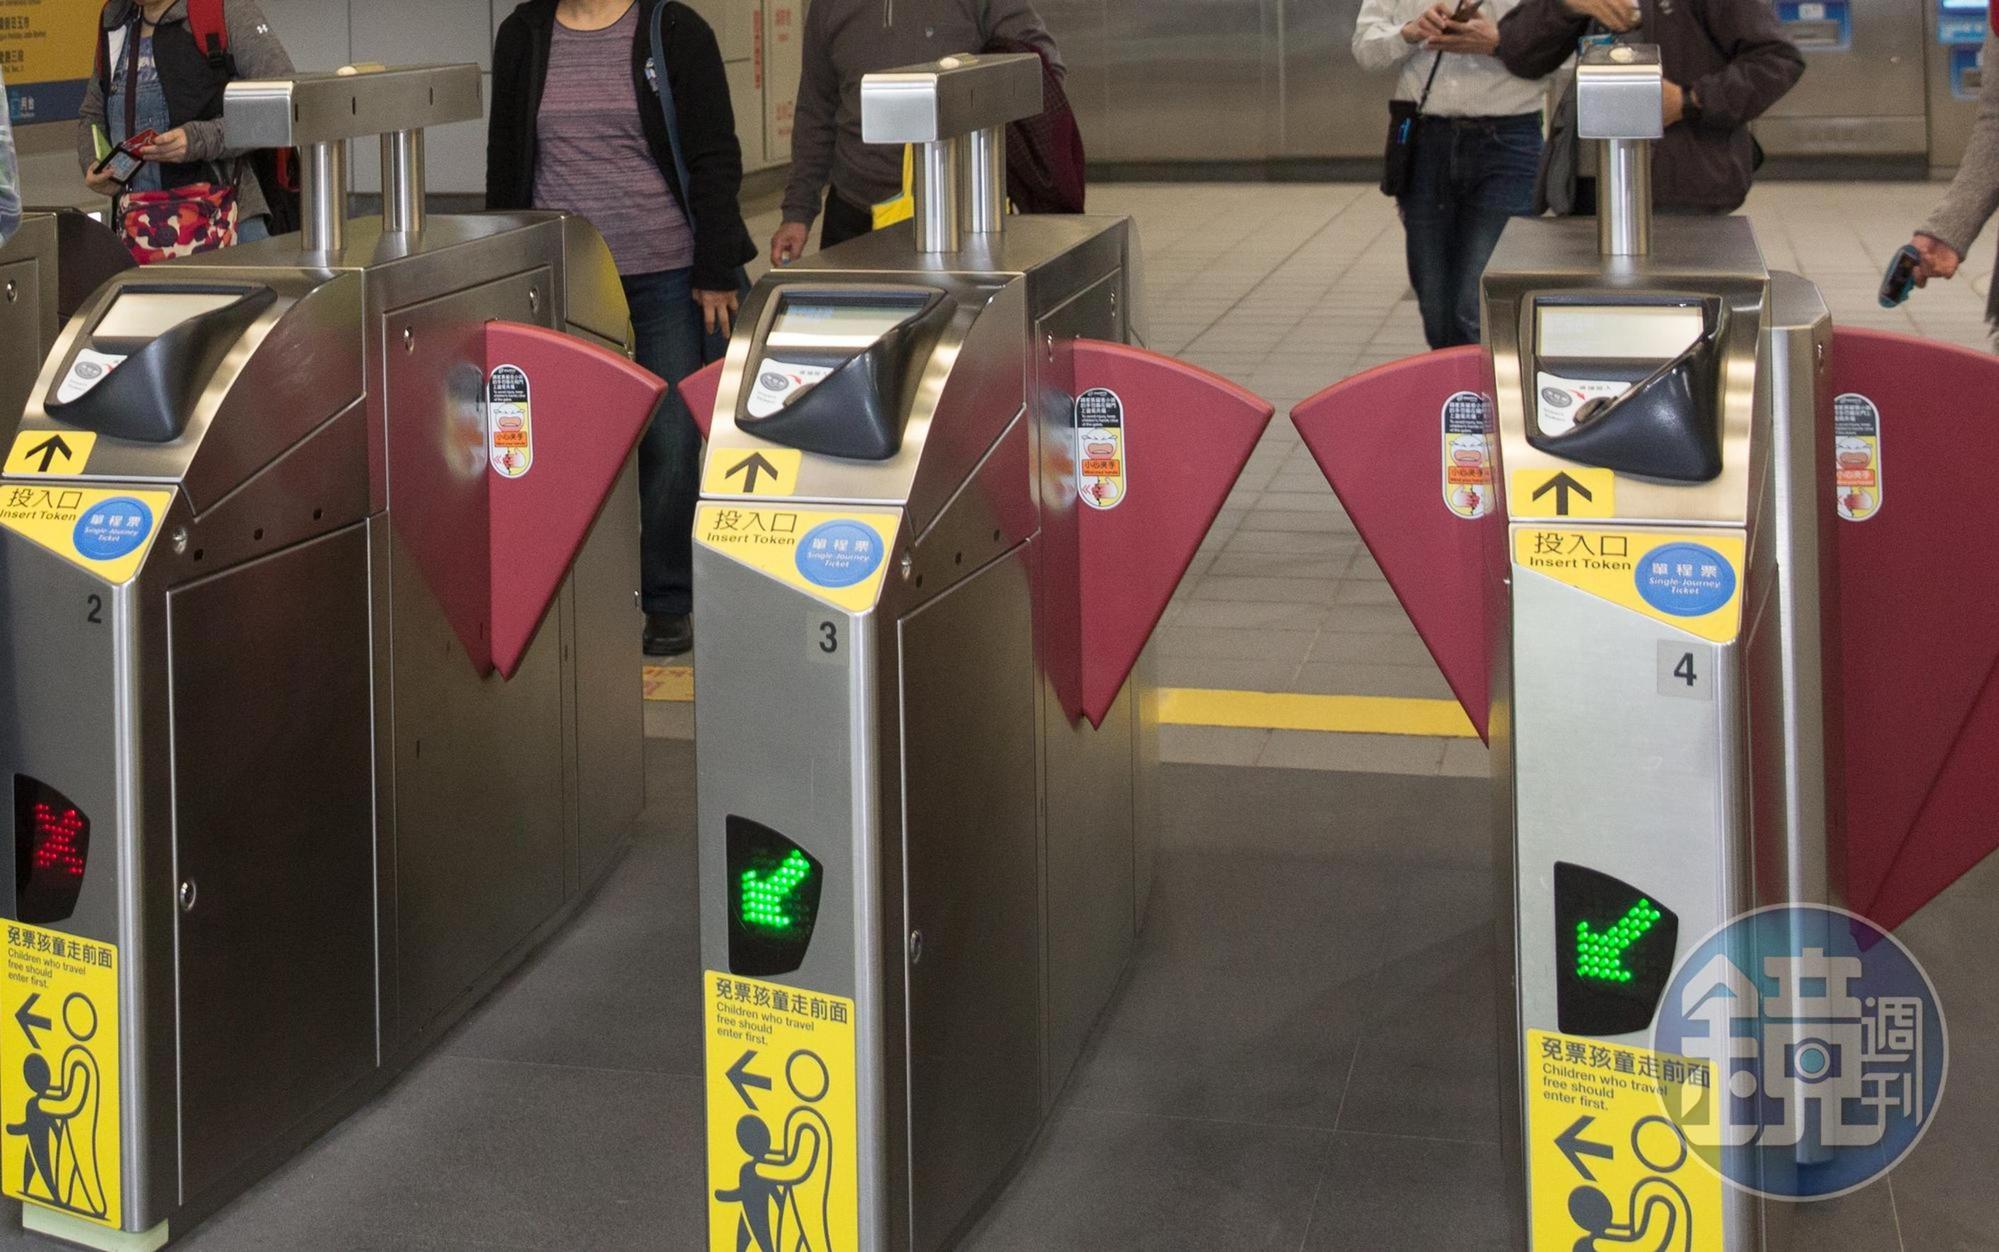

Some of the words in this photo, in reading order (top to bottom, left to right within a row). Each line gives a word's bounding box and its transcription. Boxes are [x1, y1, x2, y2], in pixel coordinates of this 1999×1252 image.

[7, 488, 82, 510] 投入口
[0, 509, 36, 520] Insert
[40, 511, 77, 521] Token
[90, 514, 142, 527] 單程票
[713, 509, 798, 533] 投入口
[707, 533, 748, 543] Insert
[754, 534, 795, 545] Token
[812, 538, 869, 552] 單程票
[1534, 532, 1628, 557] 投入口
[825, 560, 849, 568] Ticket
[1530, 556, 1577, 568] Insert
[1584, 559, 1631, 570] Token
[1652, 563, 1718, 577] 單程票
[1671, 586, 1699, 595] Ticket
[87, 594, 102, 623] 2
[819, 621, 838, 653] 3
[1673, 652, 1697, 686] 4
[8, 925, 113, 969] 免票孩童走前面
[8, 947, 41, 964] Children
[43, 959, 60, 969] who
[63, 962, 86, 976] travel
[8, 960, 24, 971] free
[26, 964, 52, 978] should
[8, 972, 29, 984] enter
[716, 977, 847, 1024] 免票孩童走前面
[716, 1002, 758, 1019] Children
[762, 1014, 783, 1024] who
[786, 1017, 814, 1031] travel
[717, 1014, 736, 1026] free
[739, 1019, 772, 1034] should
[717, 1027, 742, 1039] enter
[1542, 1036, 1710, 1088] 免票孩童走前面
[1543, 1063, 1595, 1082] Children
[1600, 1076, 1627, 1088] who
[1631, 1080, 1668, 1097] travel
[1543, 1076, 1567, 1089] free
[1571, 1081, 1614, 1099] should
[1543, 1091, 1576, 1104] enter
